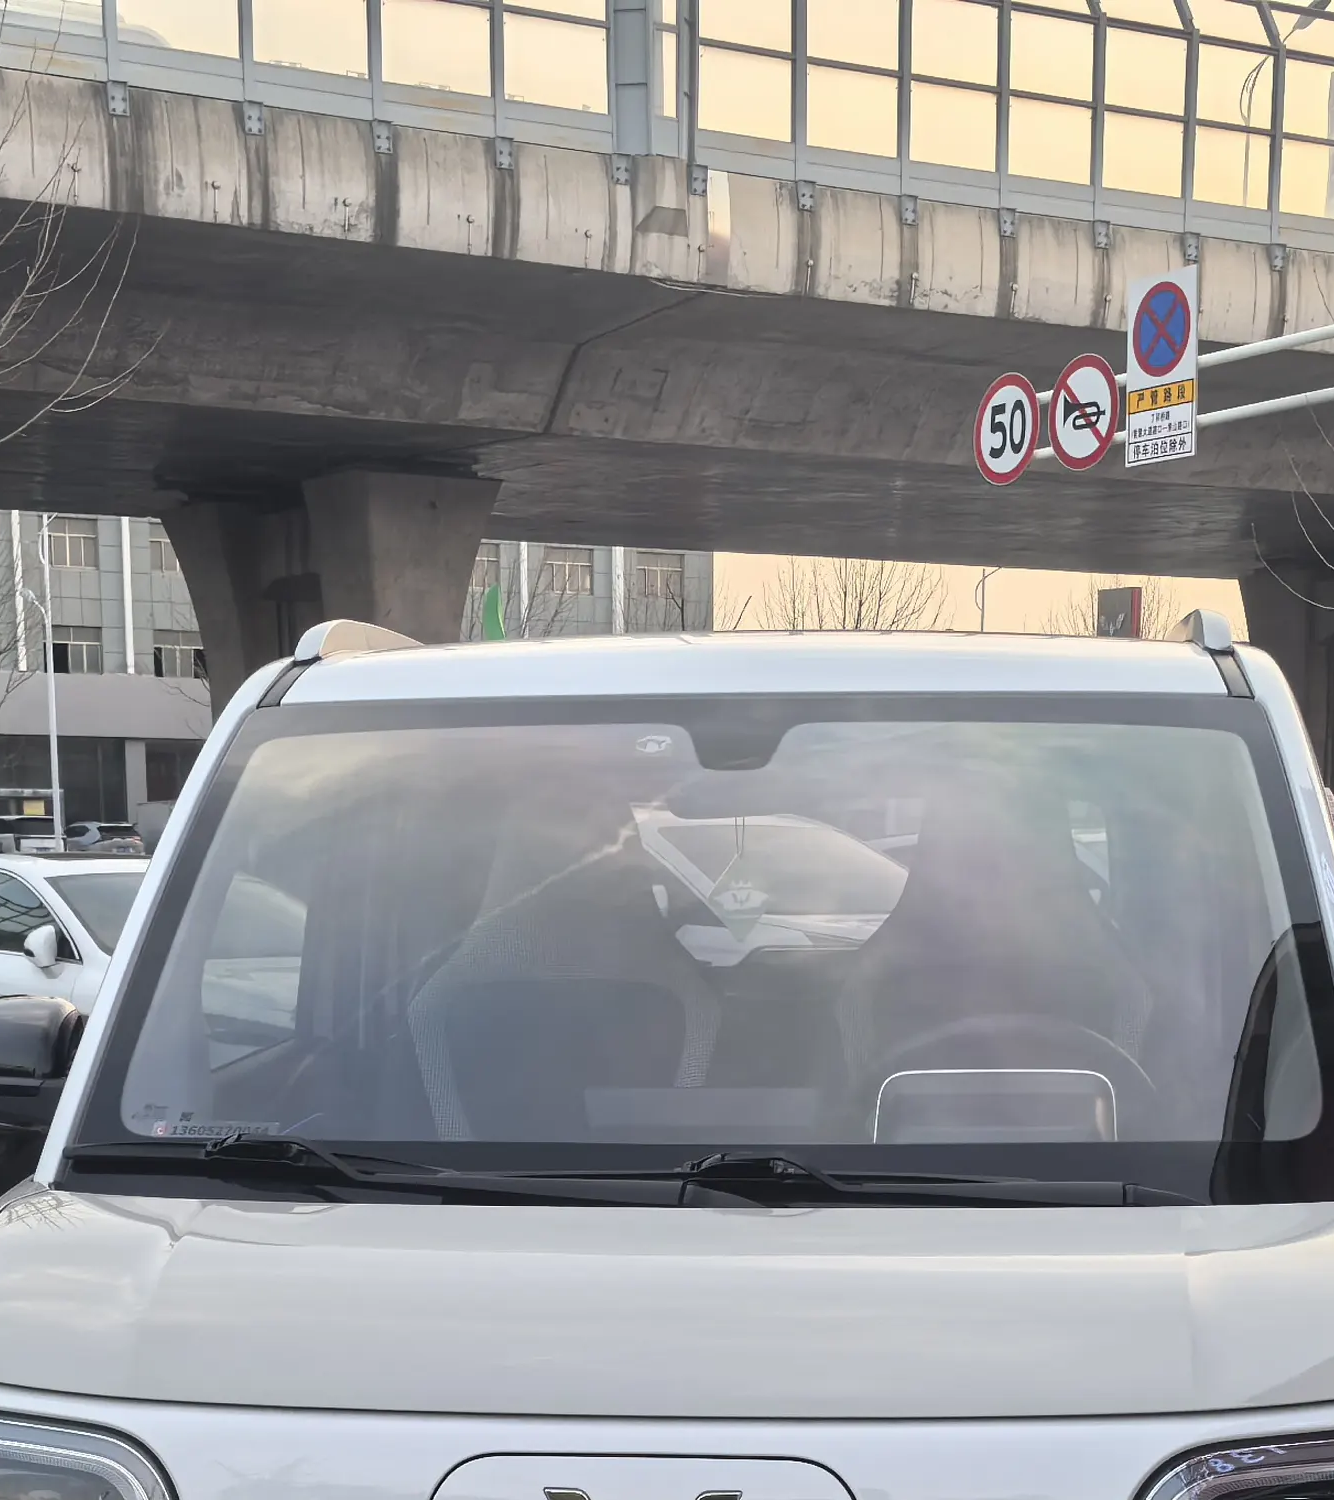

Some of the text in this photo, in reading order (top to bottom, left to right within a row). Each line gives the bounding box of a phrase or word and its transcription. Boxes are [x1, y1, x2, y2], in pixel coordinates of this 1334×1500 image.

[1136, 383, 1186, 409] 严管路段
[989, 399, 1026, 459] 50
[1133, 437, 1187, 459] 停车泊位除外
